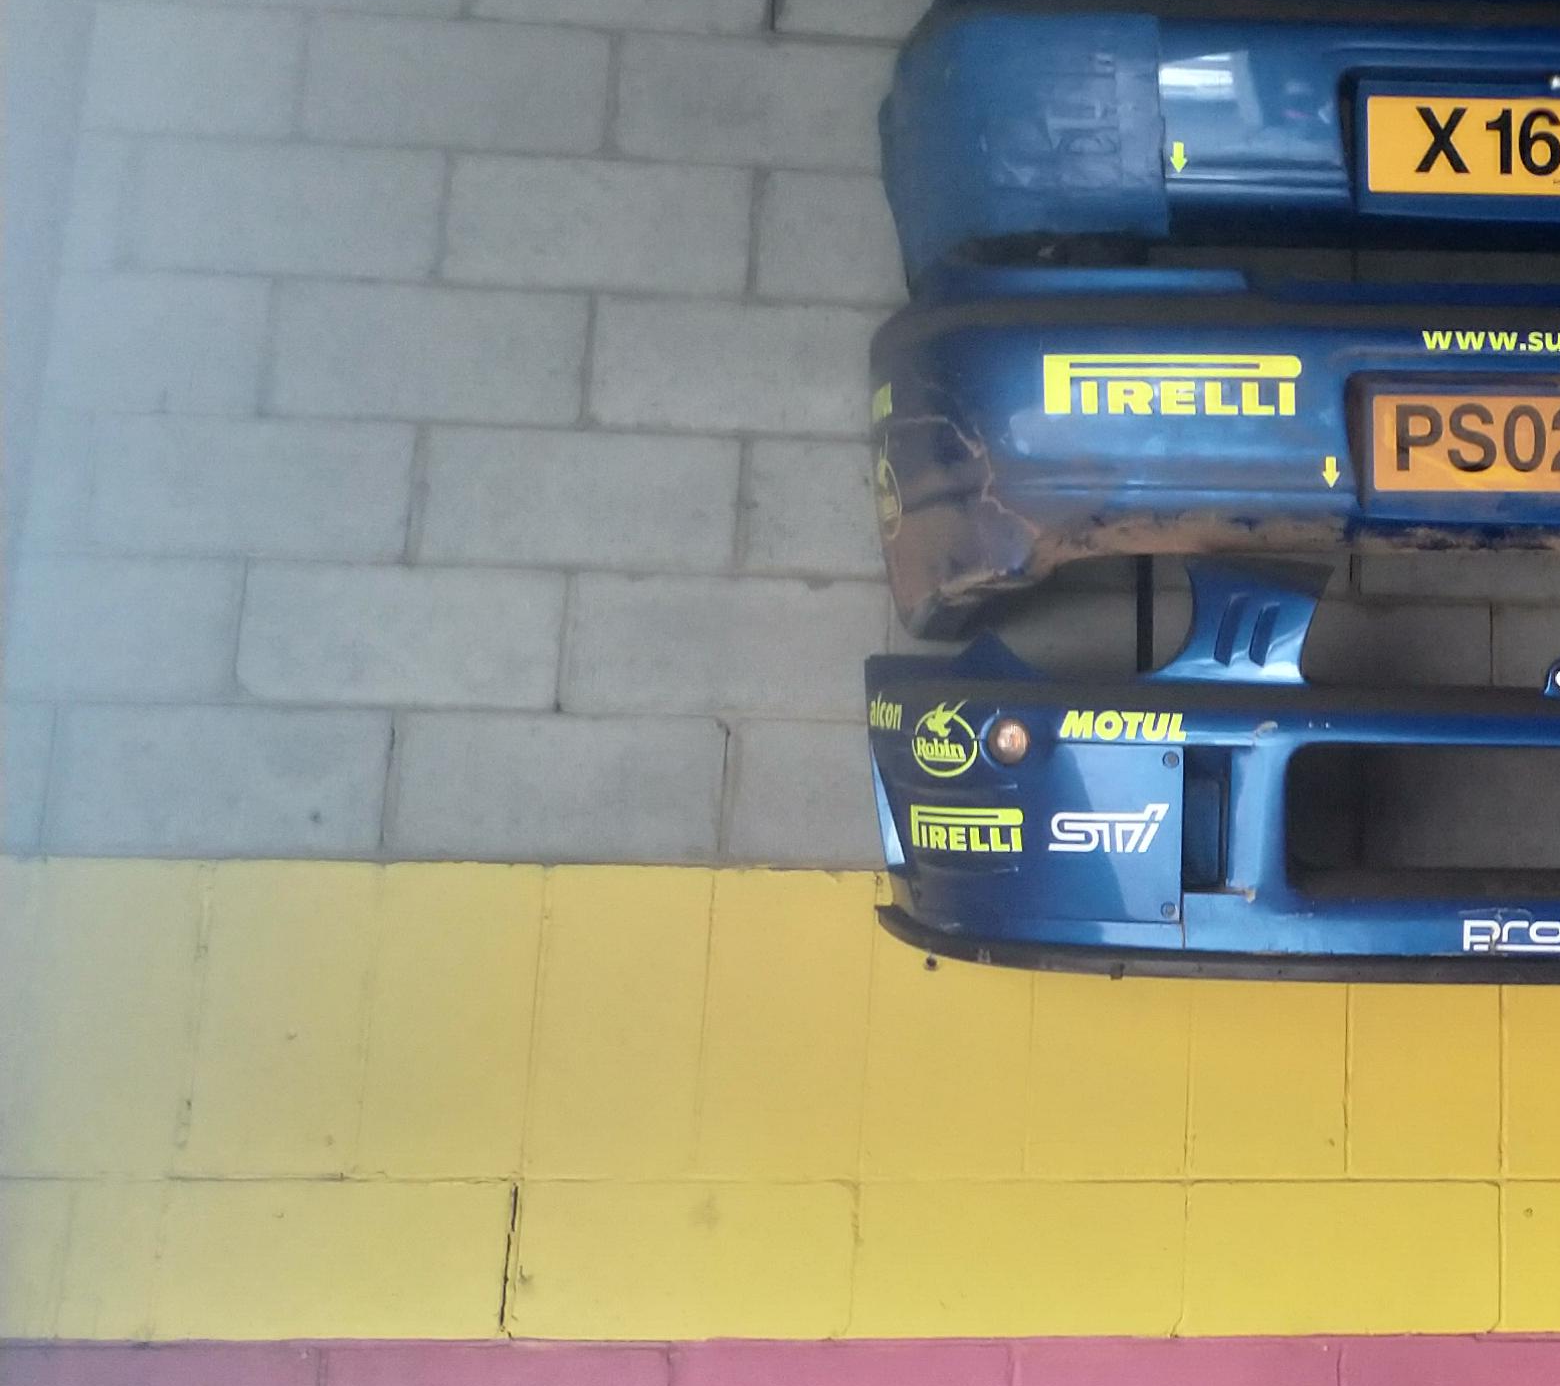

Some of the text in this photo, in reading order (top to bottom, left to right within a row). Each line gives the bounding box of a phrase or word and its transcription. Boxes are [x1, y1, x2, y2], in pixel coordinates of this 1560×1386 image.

[1043, 355, 1302, 415] PIRELLI
[1060, 710, 1187, 742] MOTUL
[915, 736, 967, 762] Robin
[910, 804, 1024, 853] PIRELLI
